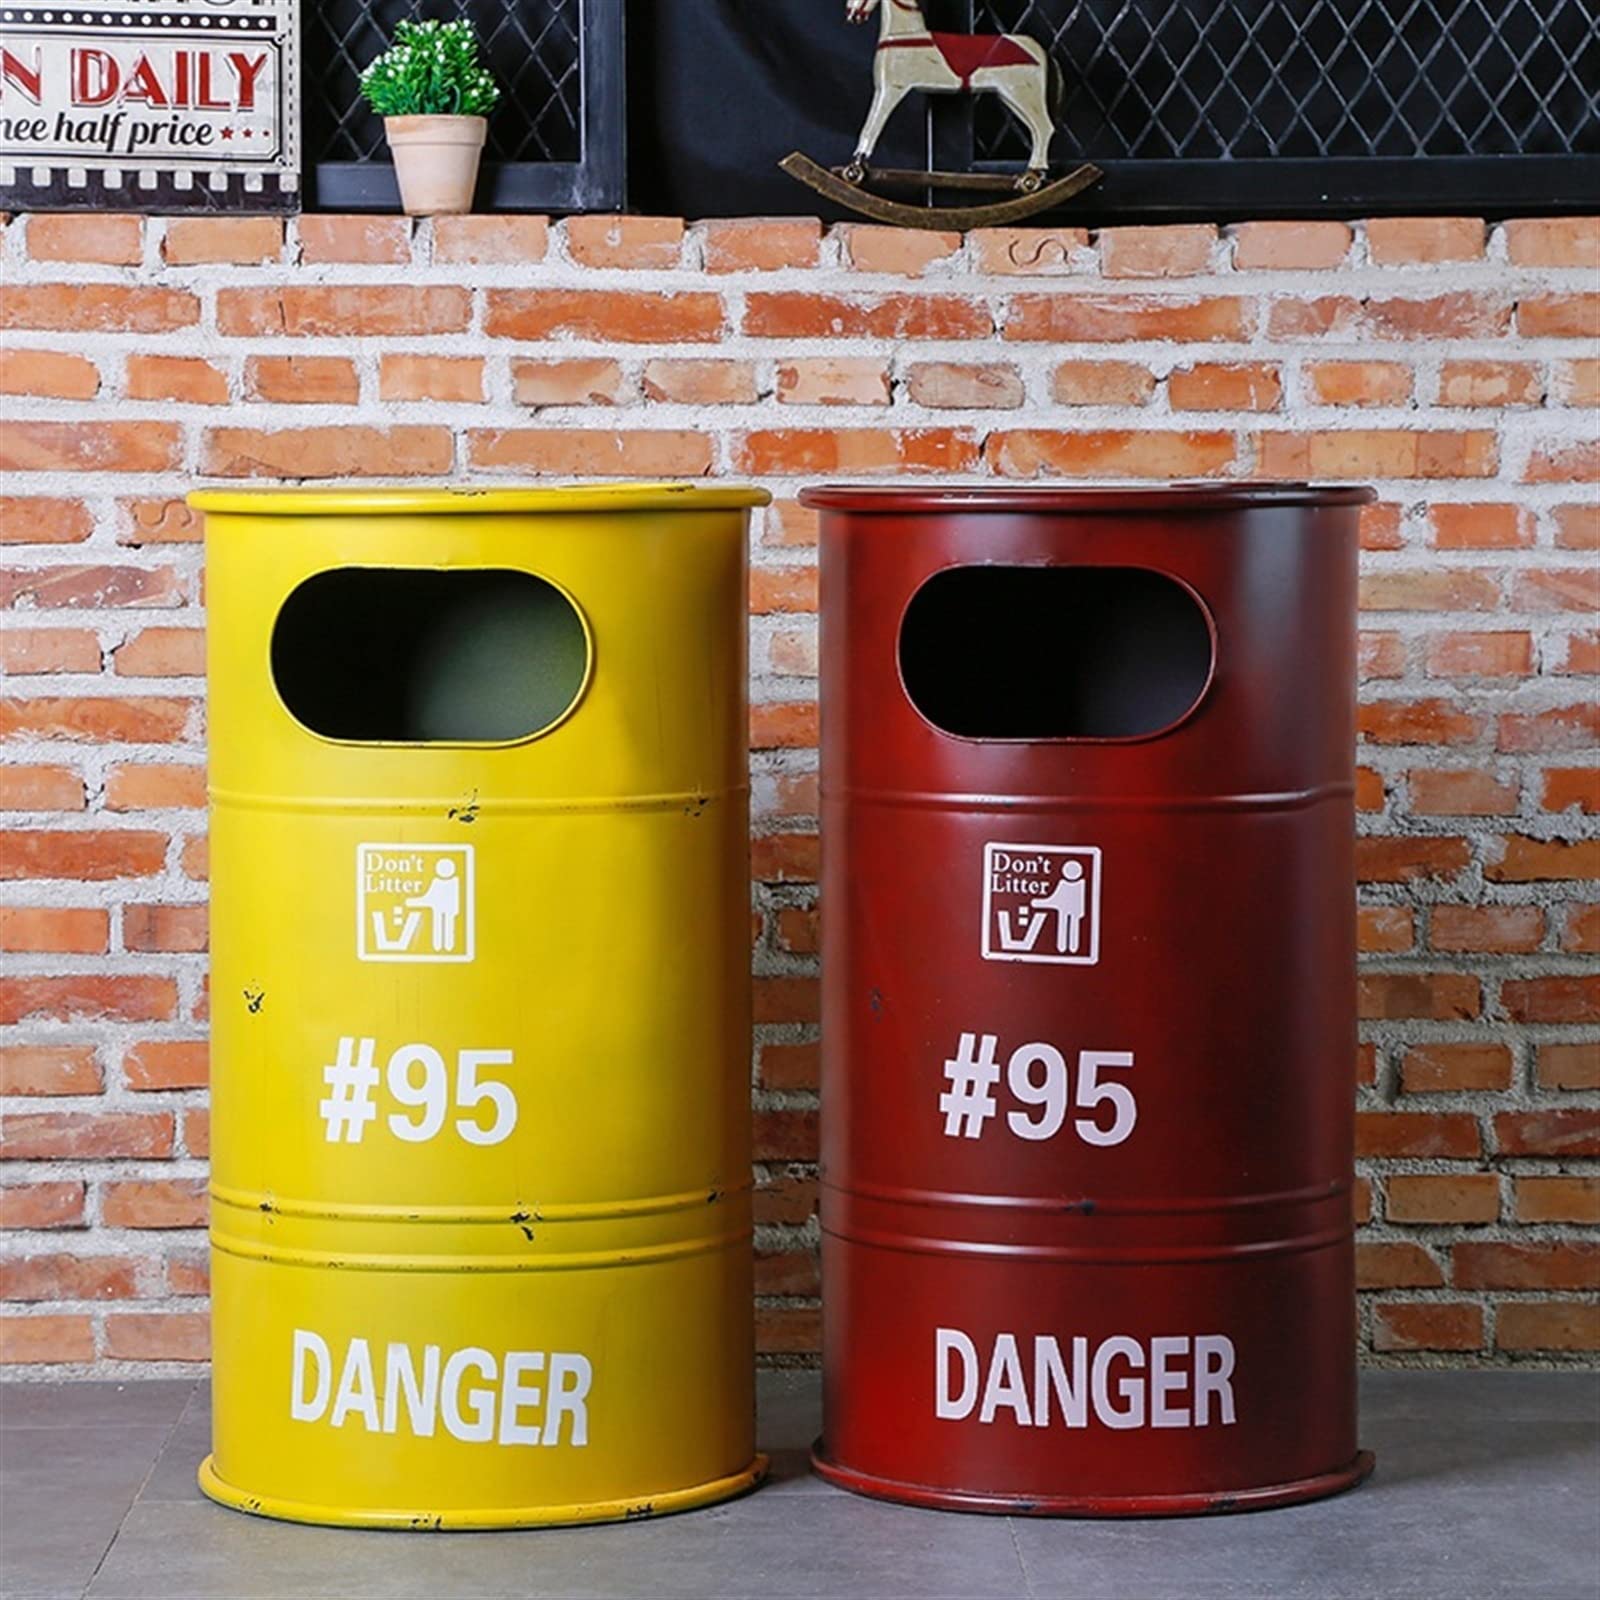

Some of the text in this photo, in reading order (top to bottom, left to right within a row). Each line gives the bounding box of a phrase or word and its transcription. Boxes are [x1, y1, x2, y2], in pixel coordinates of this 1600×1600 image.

[70, 48, 268, 111] DAILY
[53, 112, 127, 153] half
[126, 114, 214, 153] price
[365, 873, 424, 893] Litter
[366, 852, 424, 873] Don't
[991, 873, 1050, 896] Litter
[993, 852, 1052, 875] Don't
[319, 1036, 519, 1146] #95
[939, 1032, 1138, 1147] #95
[290, 1328, 593, 1447] DANGER
[935, 1327, 1238, 1430] DANGER
